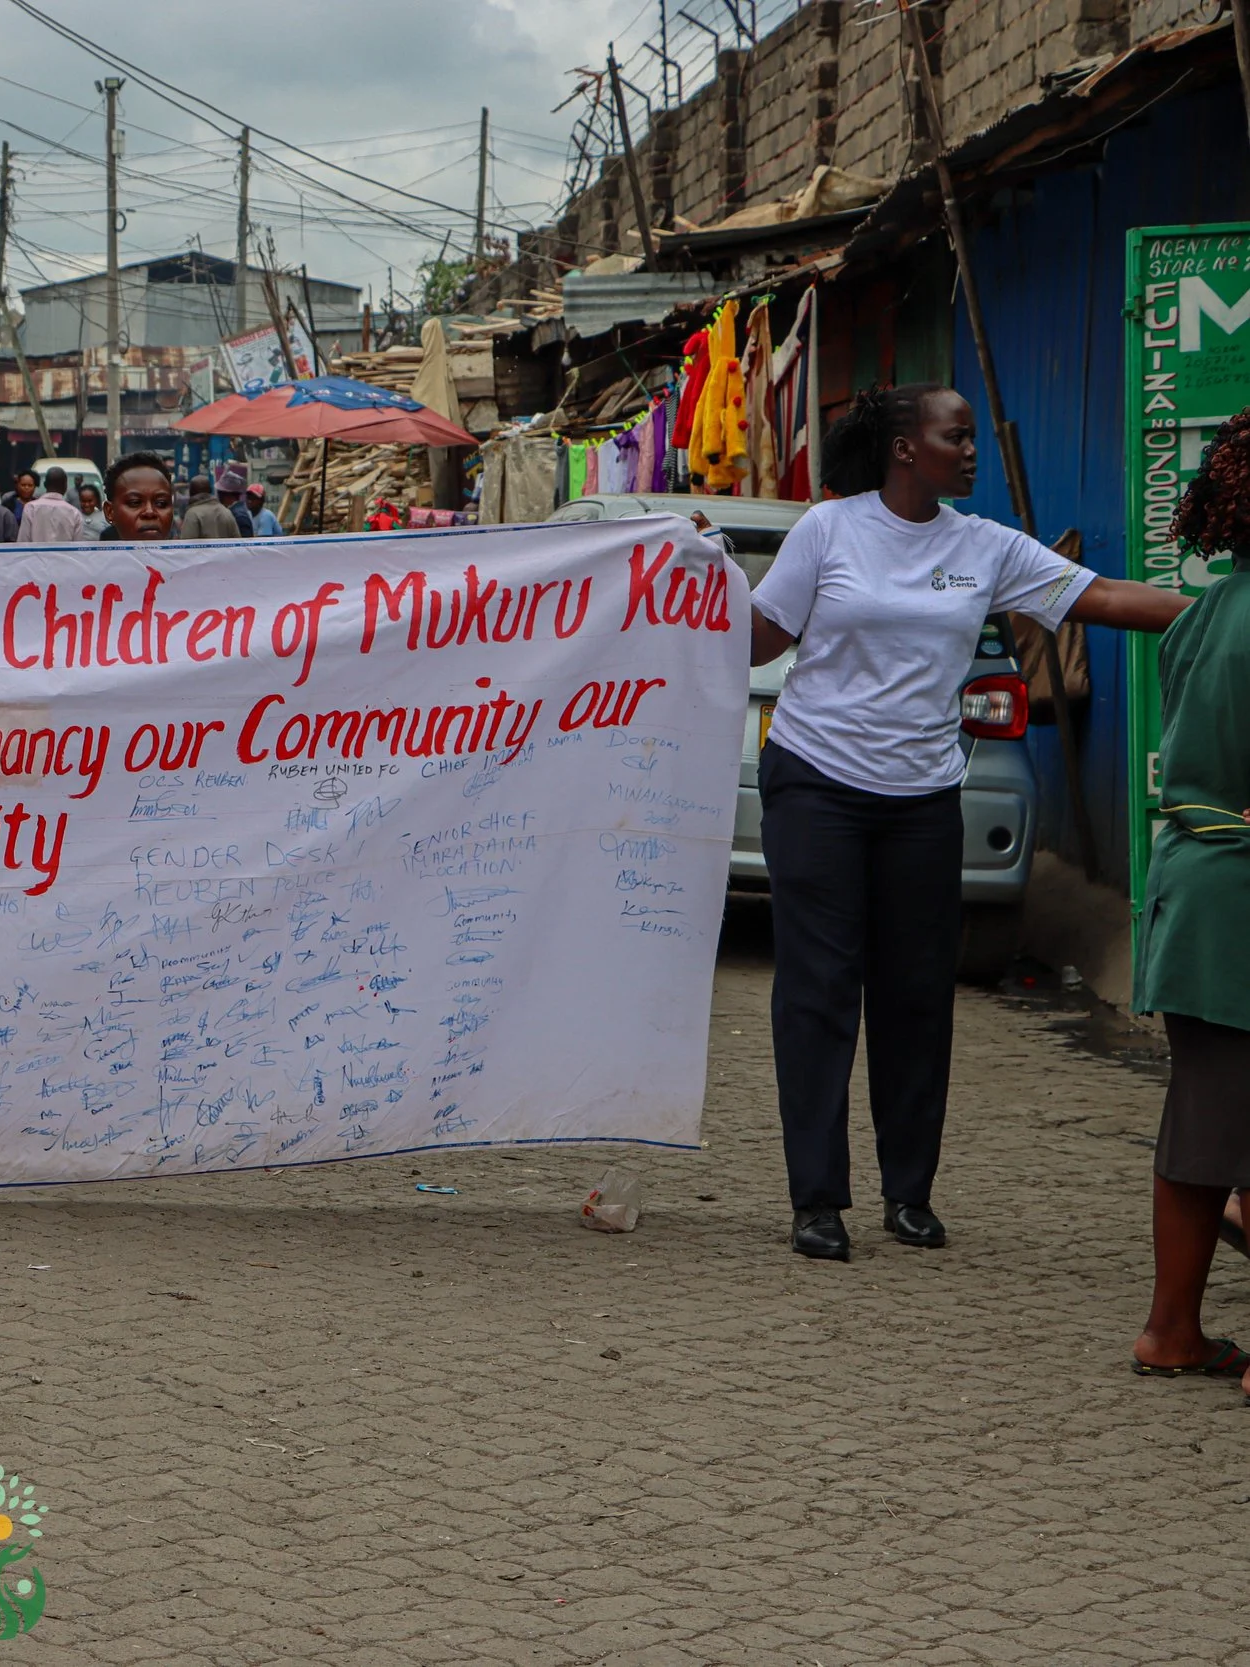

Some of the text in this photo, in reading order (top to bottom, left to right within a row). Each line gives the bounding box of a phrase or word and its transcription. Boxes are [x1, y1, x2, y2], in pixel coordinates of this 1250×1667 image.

[1149, 238, 1211, 259] AGENT
[1148, 258, 1207, 278] STORE
[1143, 281, 1179, 415] FULIZA
[948, 574, 976, 582] Ruben
[949, 581, 978, 589] Centre
[3, 566, 257, 669] Children
[272, 582, 345, 687] of
[361, 565, 593, 654] Mukuru
[621, 542, 733, 633] Kwa
[126, 723, 227, 774] our
[237, 677, 547, 765] Community
[559, 679, 667, 733] our
[325, 763, 373, 776] UNITED
[378, 764, 400, 776] FC
[138, 775, 186, 789] OCS
[130, 845, 243, 870] GENDER
[265, 841, 341, 868] DESK
[134, 871, 255, 907] REUBEN
